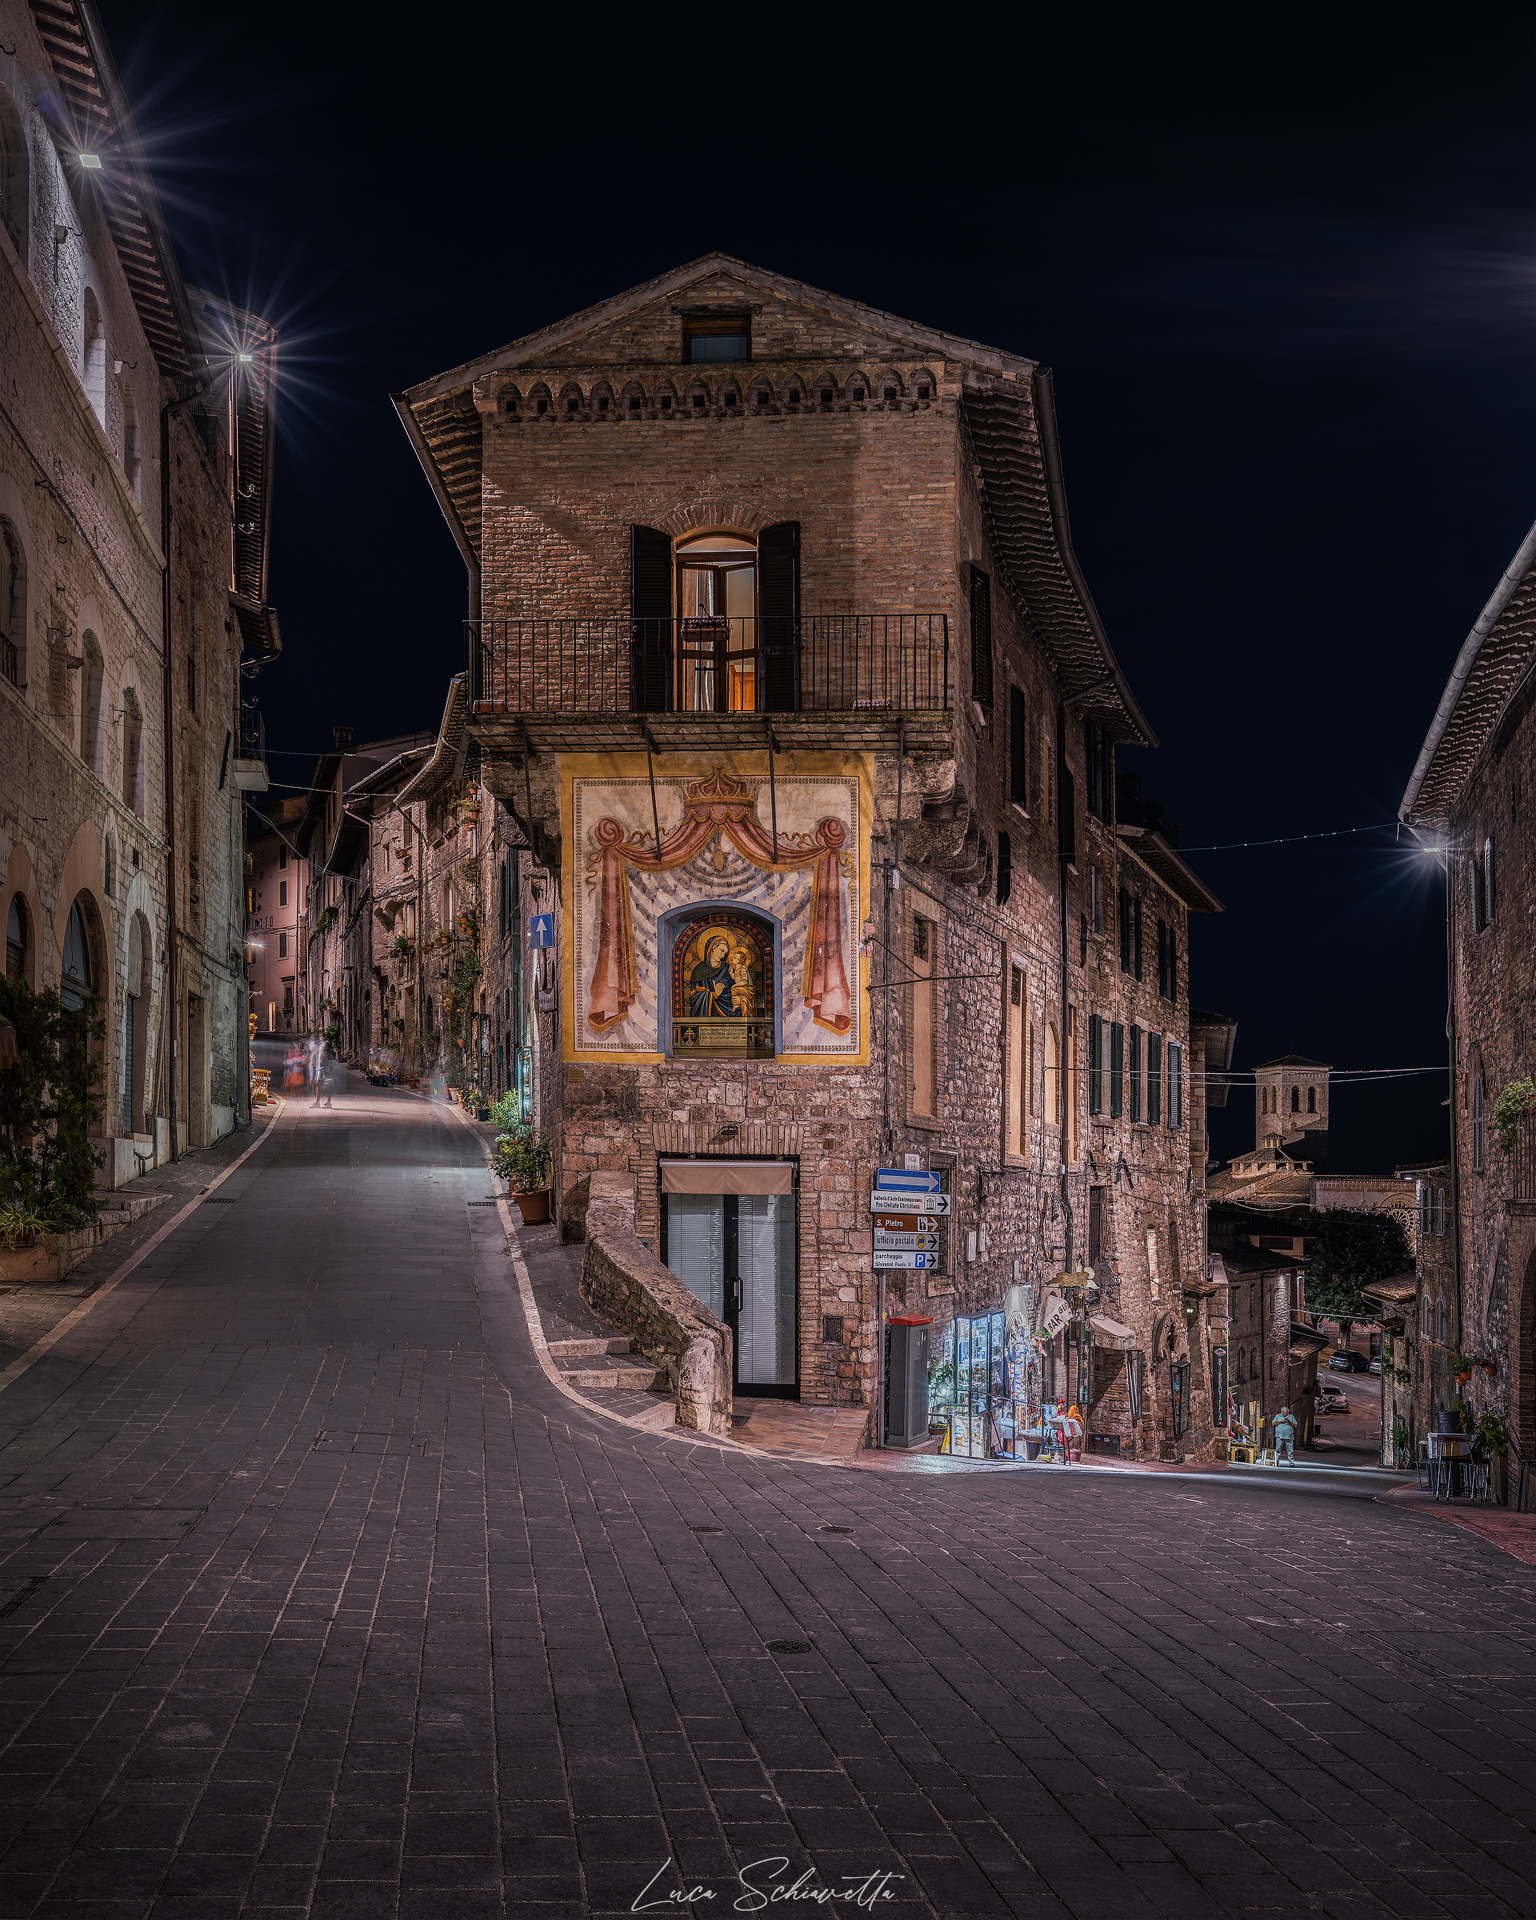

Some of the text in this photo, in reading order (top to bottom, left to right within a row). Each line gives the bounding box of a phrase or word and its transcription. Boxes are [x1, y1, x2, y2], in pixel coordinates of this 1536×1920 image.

[885, 1219, 904, 1227] Pietro
[877, 1236, 915, 1246] ufficio postale
[1047, 1314, 1063, 1332] BAR
